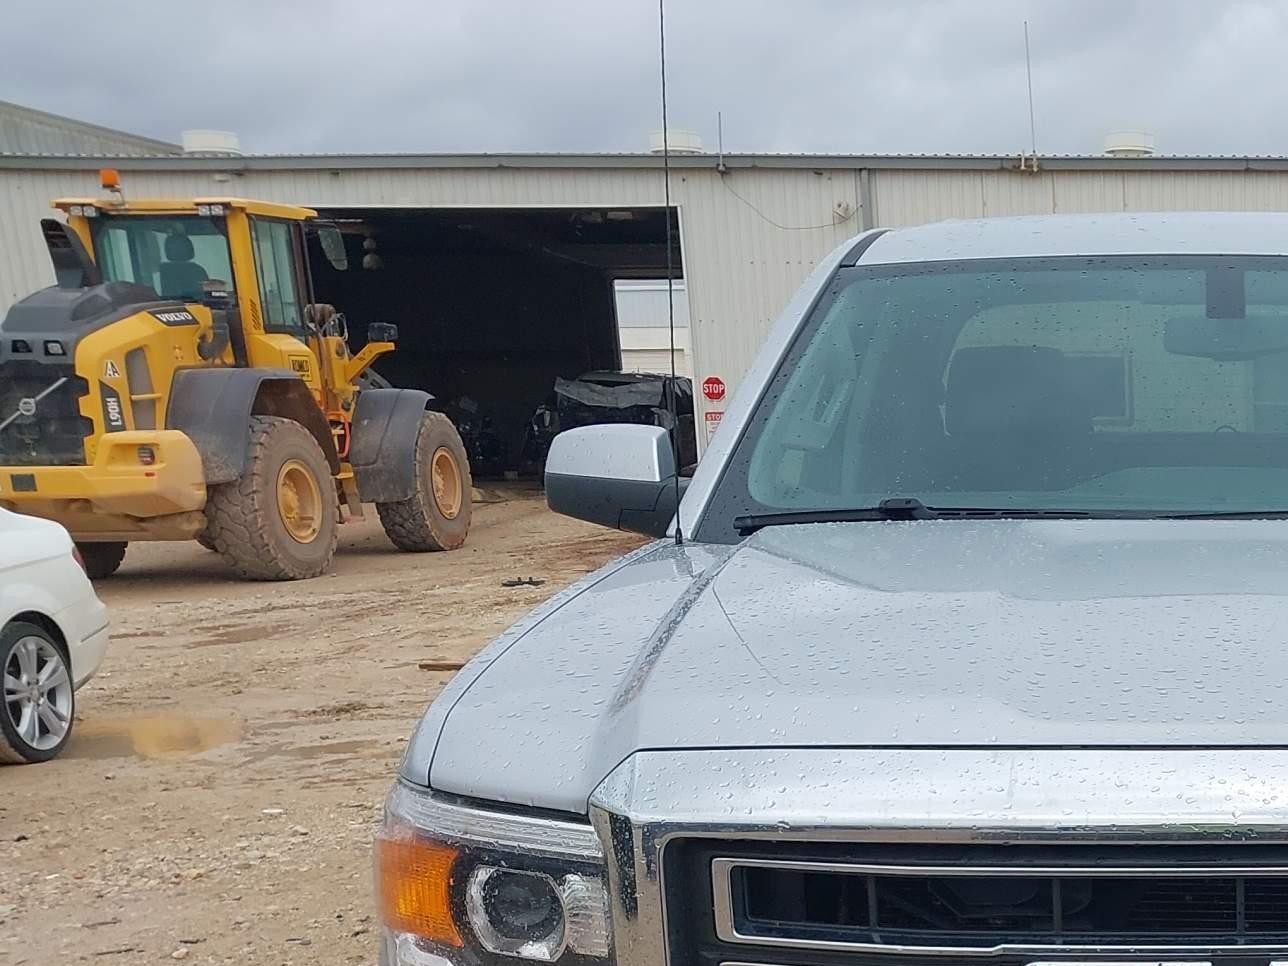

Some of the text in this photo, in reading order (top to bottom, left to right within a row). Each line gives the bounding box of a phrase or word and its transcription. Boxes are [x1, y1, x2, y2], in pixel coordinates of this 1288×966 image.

[154, 311, 193, 323] VOLVO
[703, 383, 725, 394] STOP
[105, 397, 122, 426] L90H
